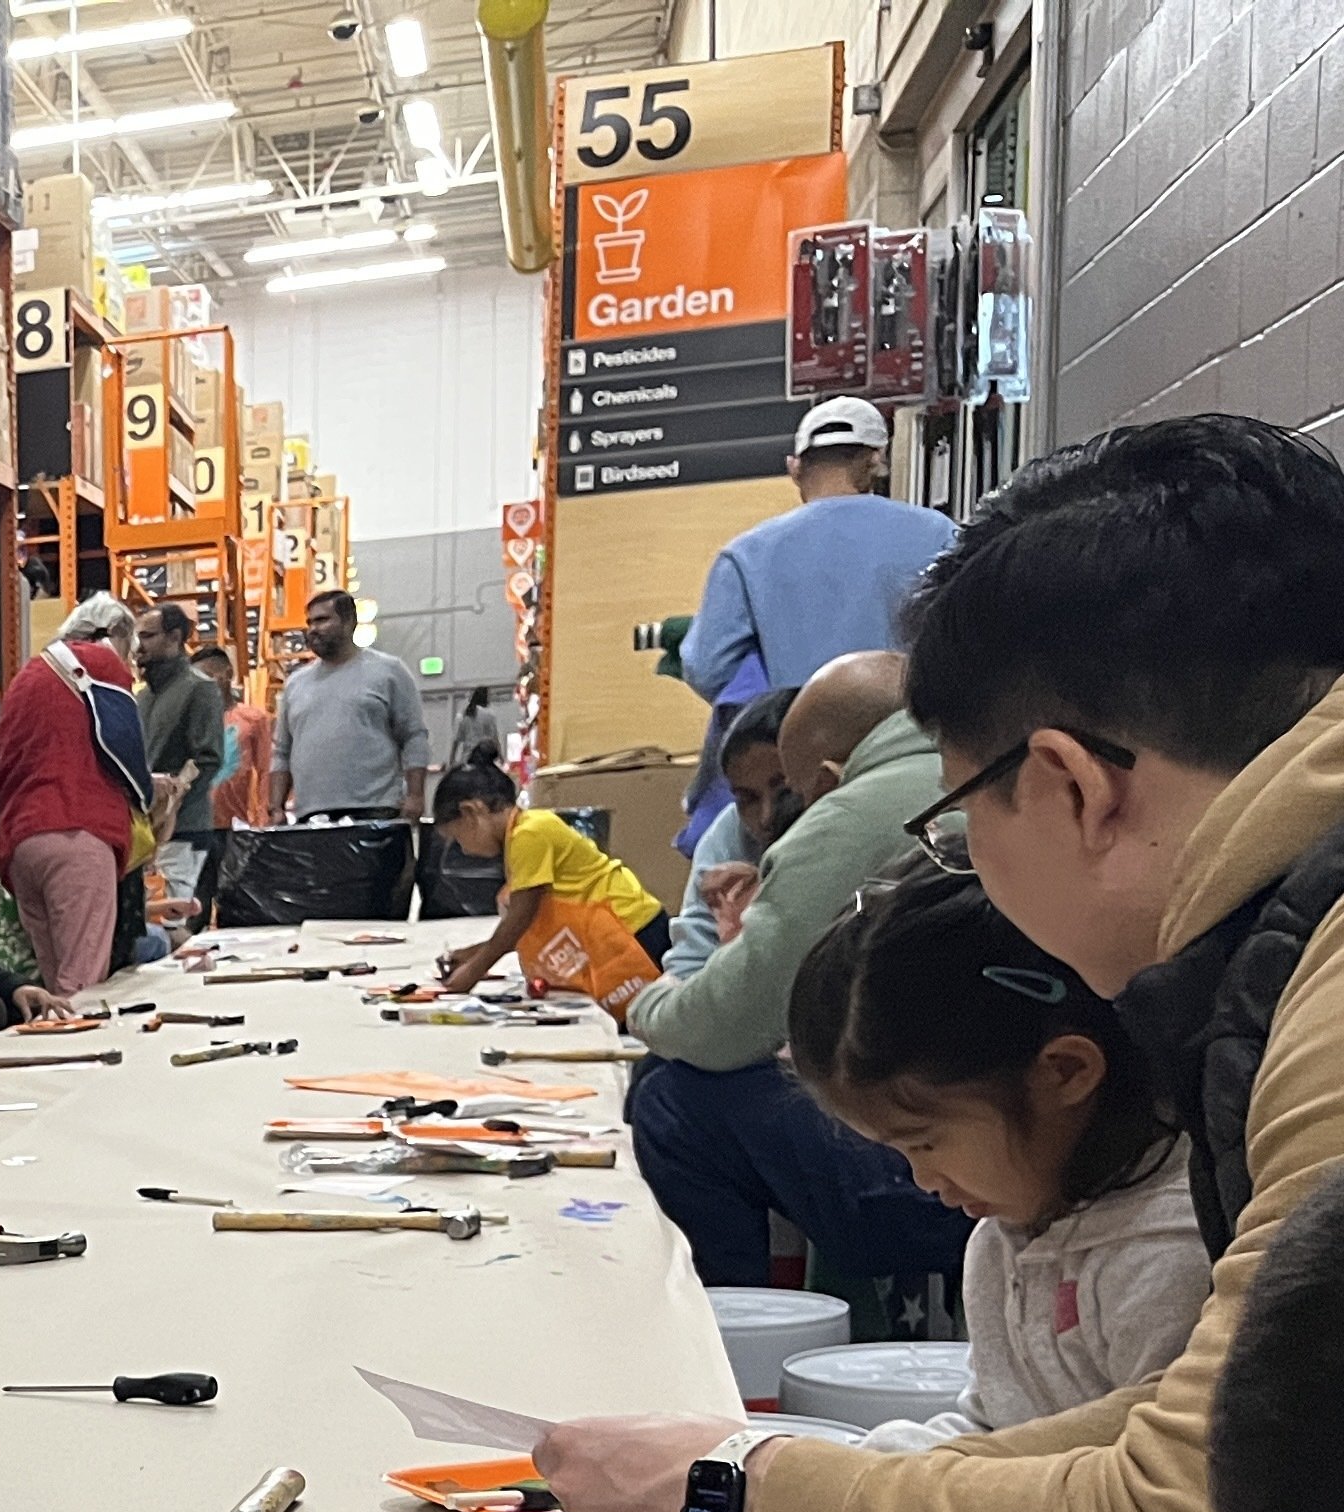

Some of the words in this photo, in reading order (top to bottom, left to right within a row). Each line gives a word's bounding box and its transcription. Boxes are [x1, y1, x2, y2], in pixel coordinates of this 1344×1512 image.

[576, 78, 692, 169] 55
[588, 285, 734, 326] Garden
[16, 299, 53, 360] 8
[592, 345, 677, 369] Pesticides
[591, 384, 679, 407] Chemicals
[127, 394, 157, 441] 9
[590, 427, 664, 449] Sprayers
[600, 461, 679, 483] Birdseed
